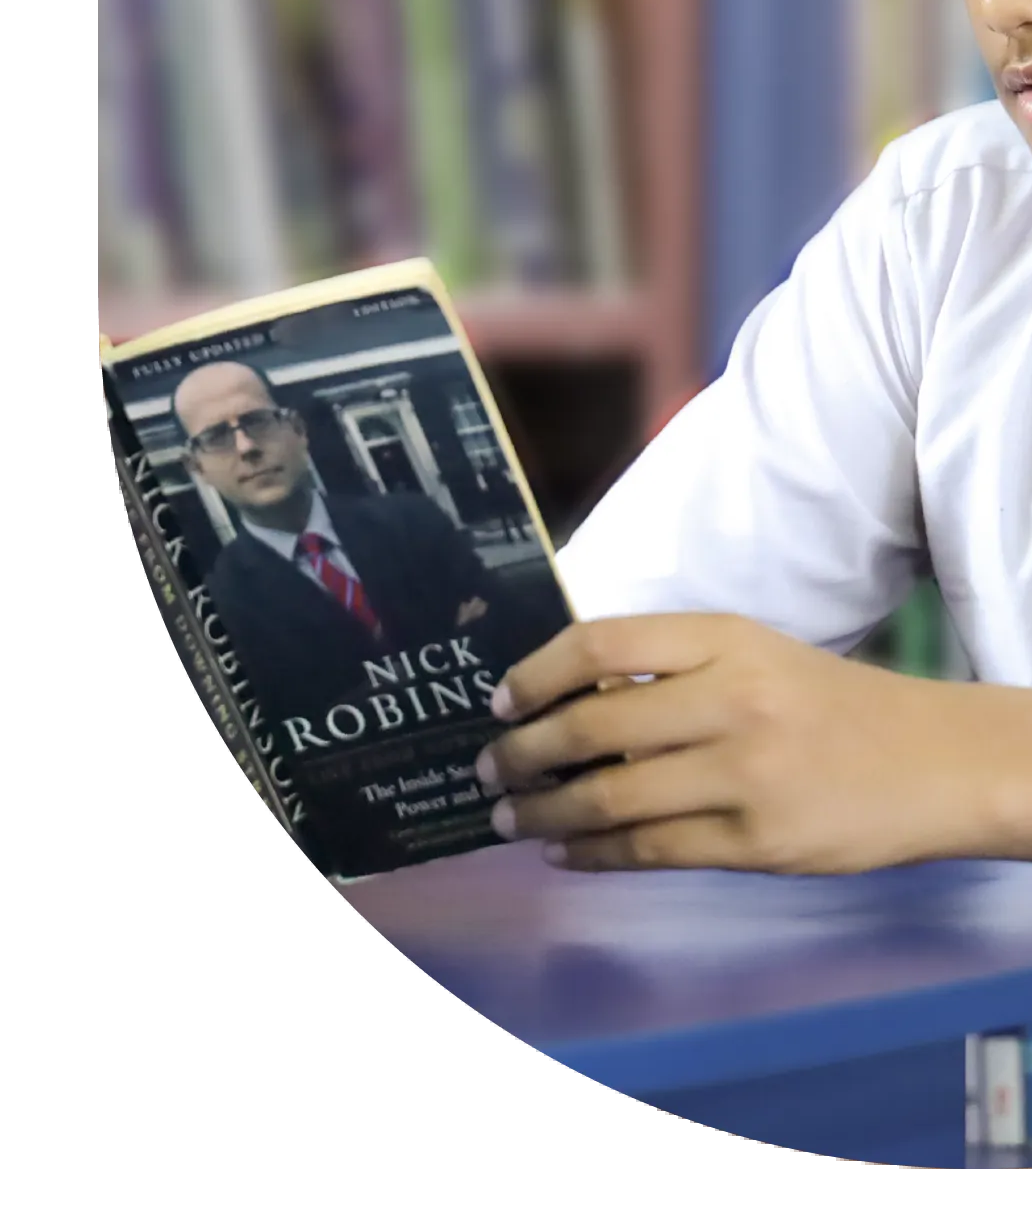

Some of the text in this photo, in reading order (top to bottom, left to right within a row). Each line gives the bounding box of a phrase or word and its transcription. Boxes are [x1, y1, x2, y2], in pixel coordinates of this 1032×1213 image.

[132, 295, 420, 379] FULLY UPDATED EDITION
[125, 450, 187, 566] NICK
[362, 636, 481, 688] NICK
[281, 669, 495, 753] ROBINS
[359, 783, 395, 802] The
[398, 768, 445, 793] Inside
[395, 795, 447, 819] Power
